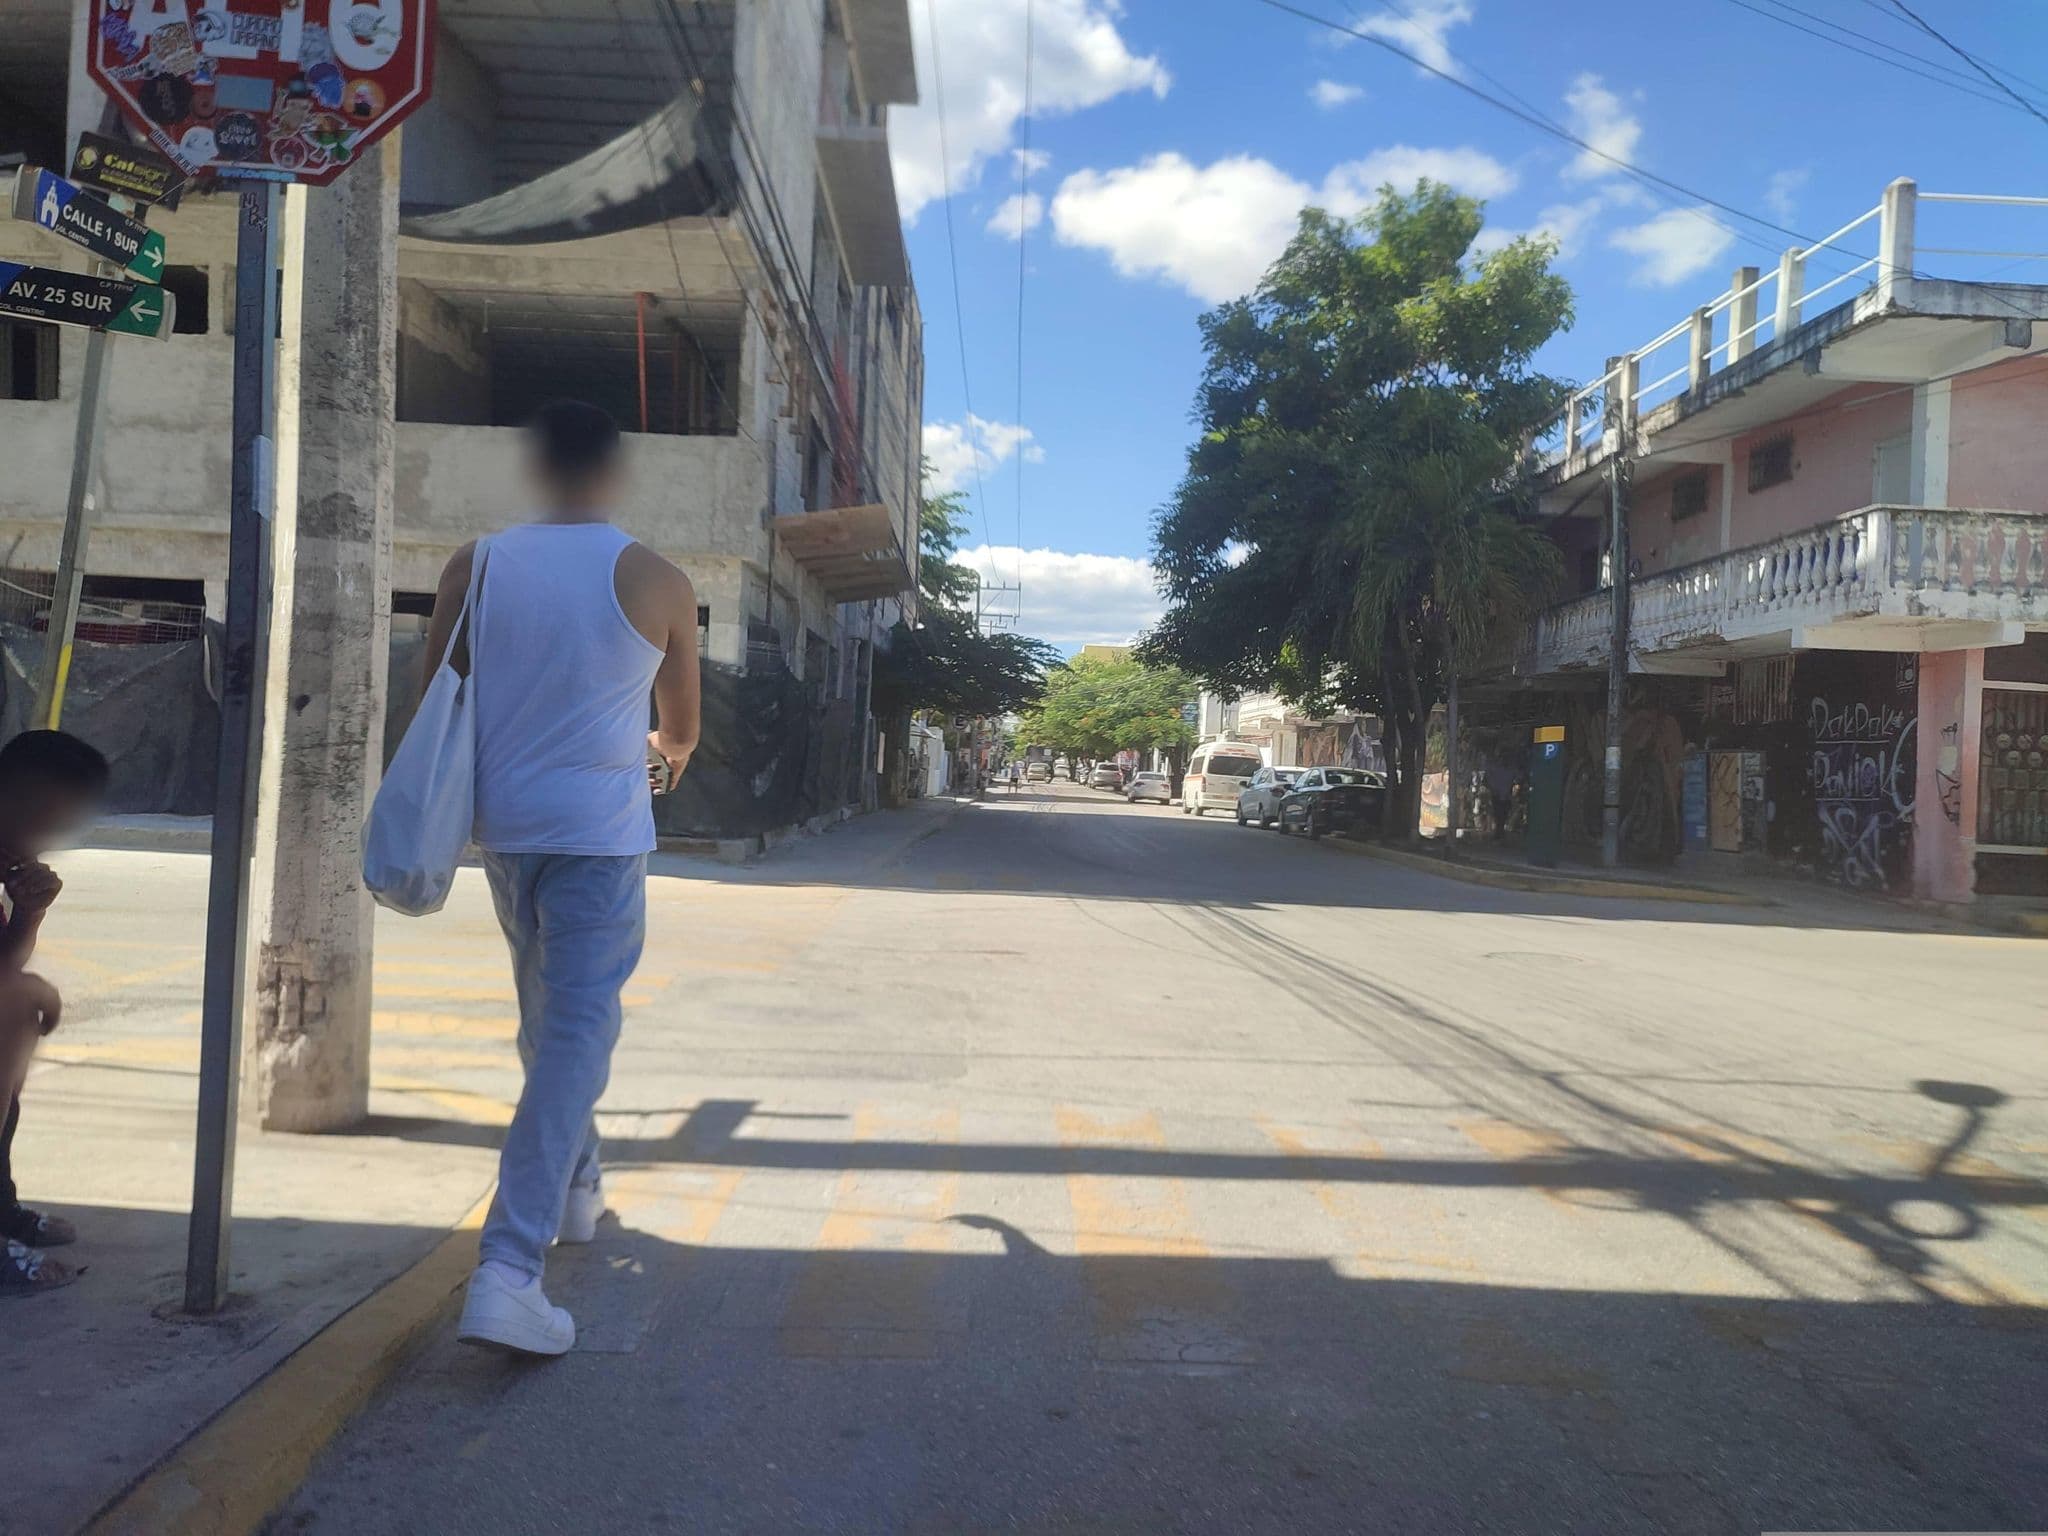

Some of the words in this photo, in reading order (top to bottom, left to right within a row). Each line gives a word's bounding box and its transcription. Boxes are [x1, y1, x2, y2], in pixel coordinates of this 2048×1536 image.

[63, 204, 104, 237] CALLE
[105, 227, 112, 242] 1
[114, 232, 139, 256] SUR
[8, 280, 38, 300] AV.
[44, 286, 67, 305] 25
[71, 291, 112, 313] SUR
[1545, 744, 1555, 756] P
